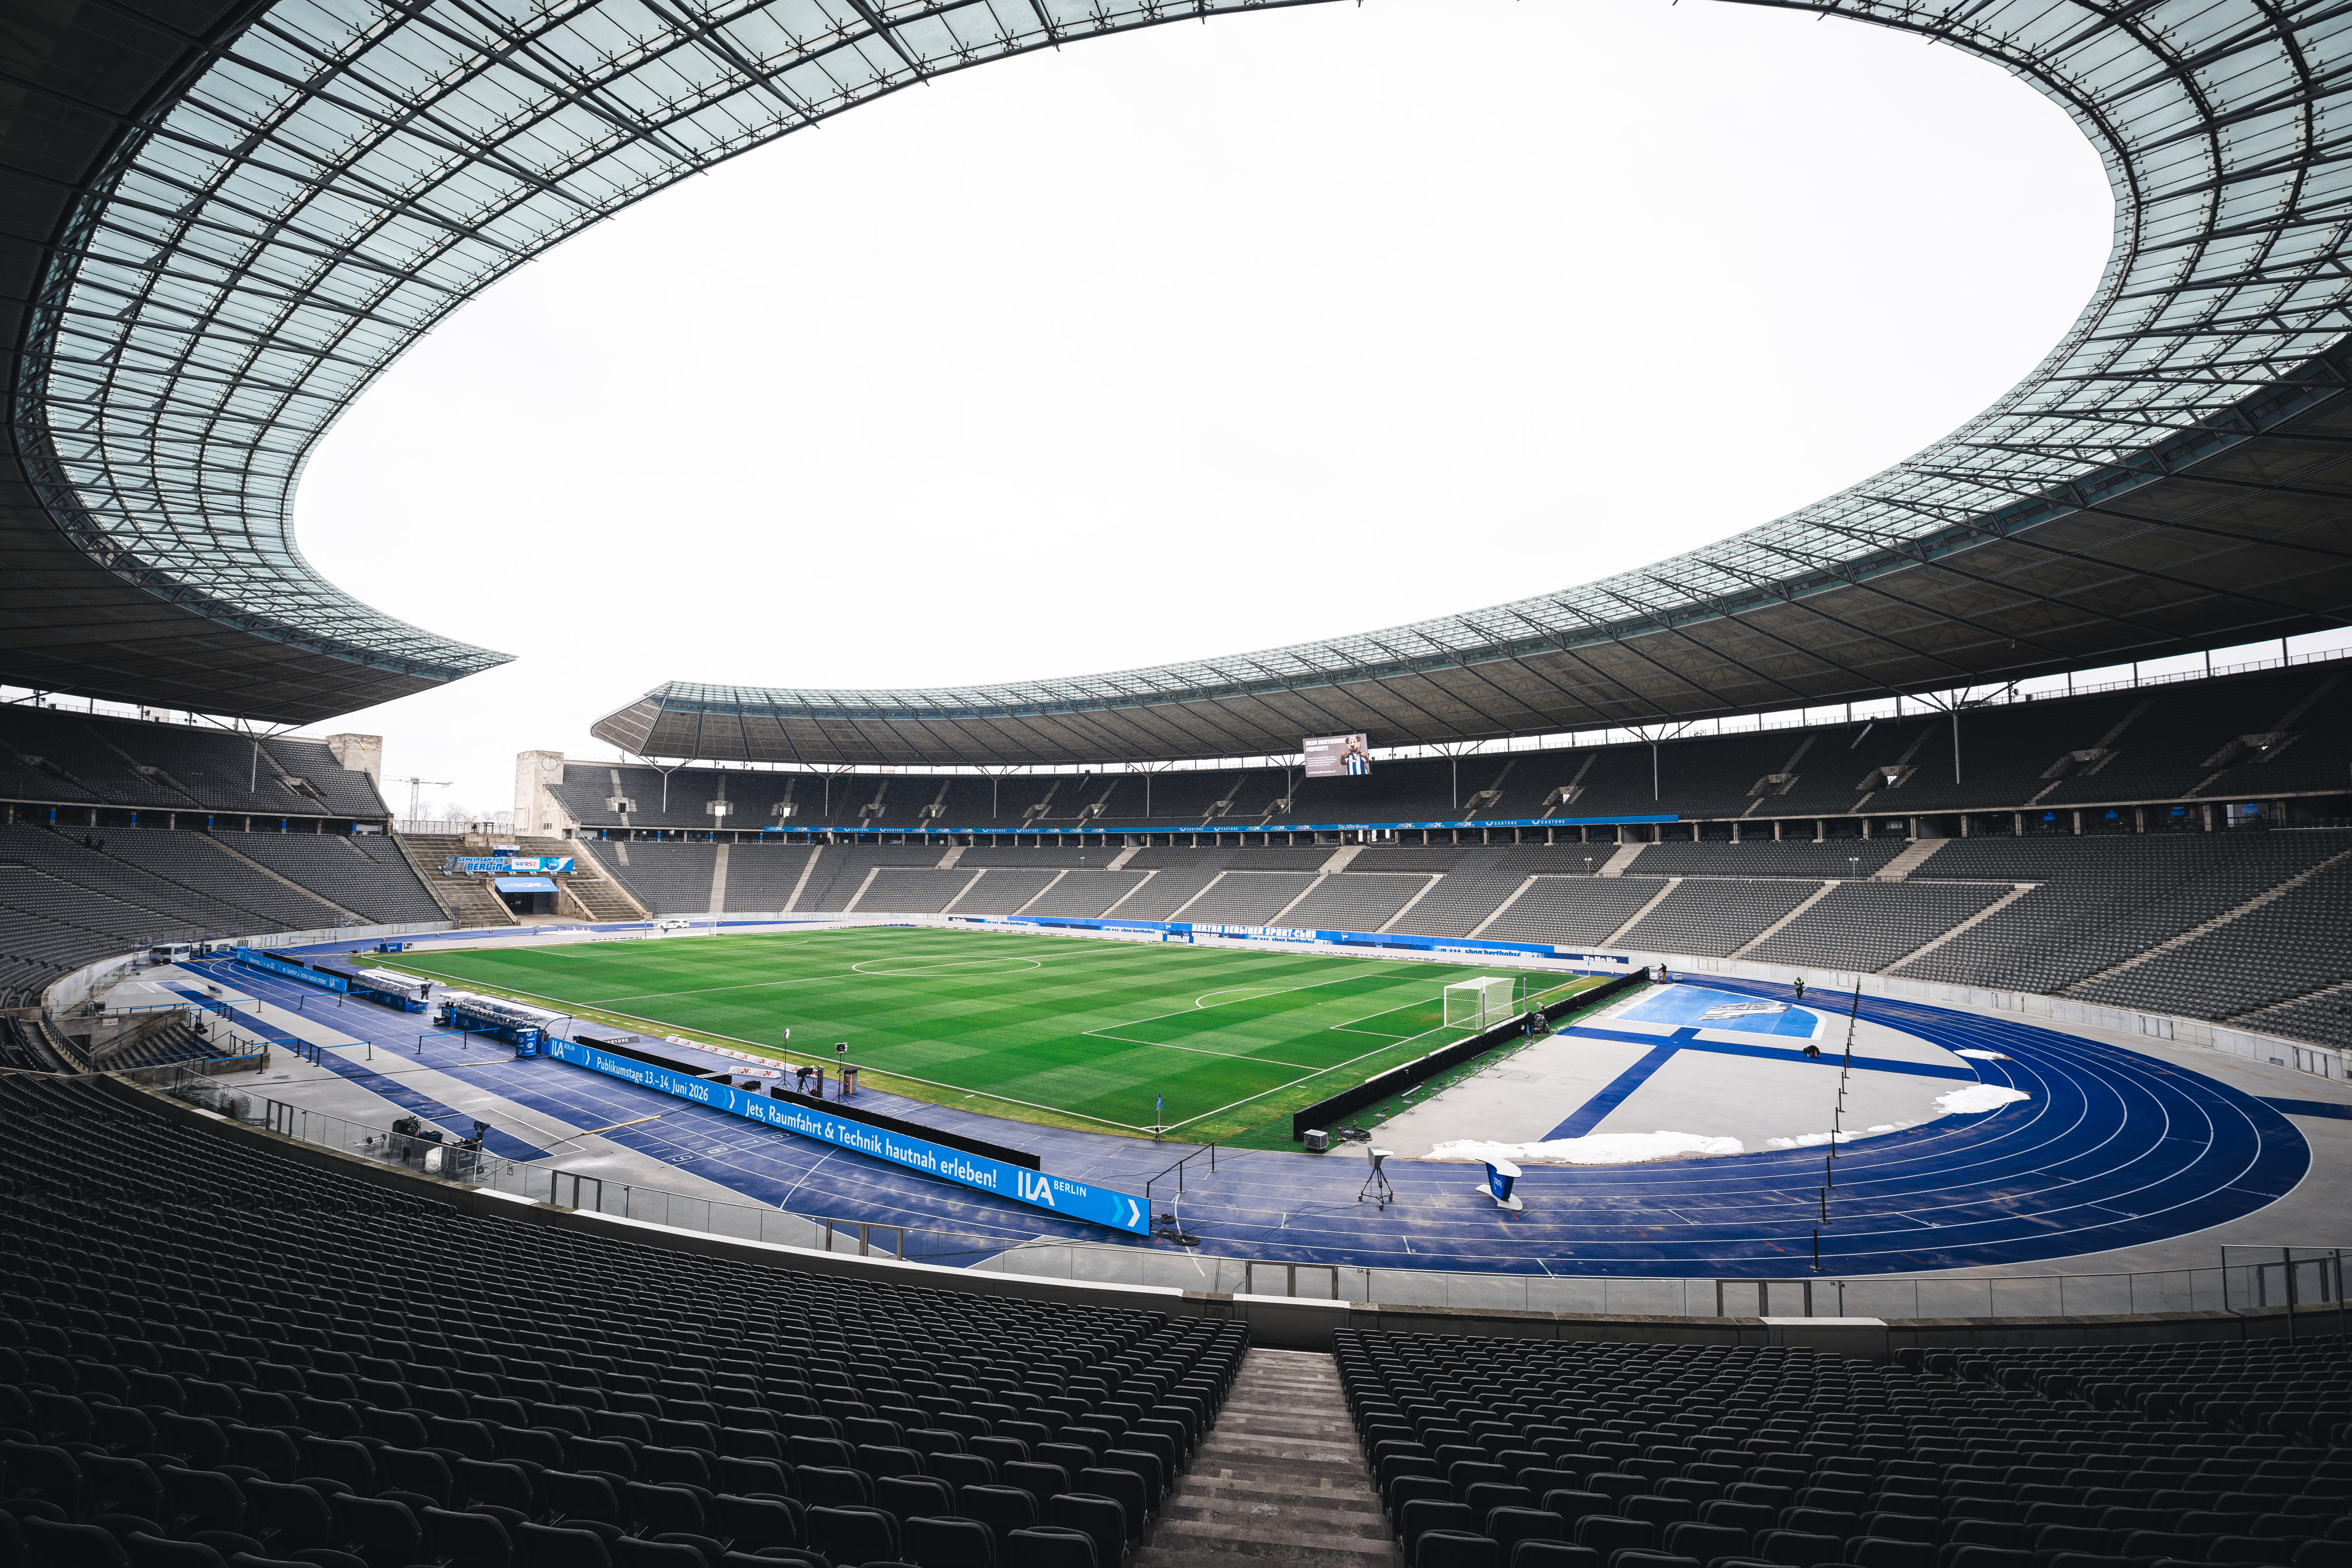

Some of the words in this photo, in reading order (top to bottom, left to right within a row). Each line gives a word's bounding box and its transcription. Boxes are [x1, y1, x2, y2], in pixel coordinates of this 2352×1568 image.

[1192, 924, 1223, 933] HERTHA
[1265, 928, 1316, 938] SPORT-CLUB
[551, 1040, 564, 1058] ILA
[563, 1043, 575, 1052] BERLIN
[597, 1057, 643, 1083] Publikumstage
[672, 1079, 687, 1095] Juni
[689, 1083, 709, 1101] 2026
[745, 1099, 766, 1122] Jets,
[769, 1105, 822, 1136] Raumfahrt
[825, 1122, 834, 1139] &
[838, 1125, 882, 1154] Technik
[886, 1138, 936, 1170] hautnah
[941, 1158, 997, 1188] erleben!
[1018, 1171, 1055, 1206] ILA
[1054, 1180, 1087, 1197] BERLIN
